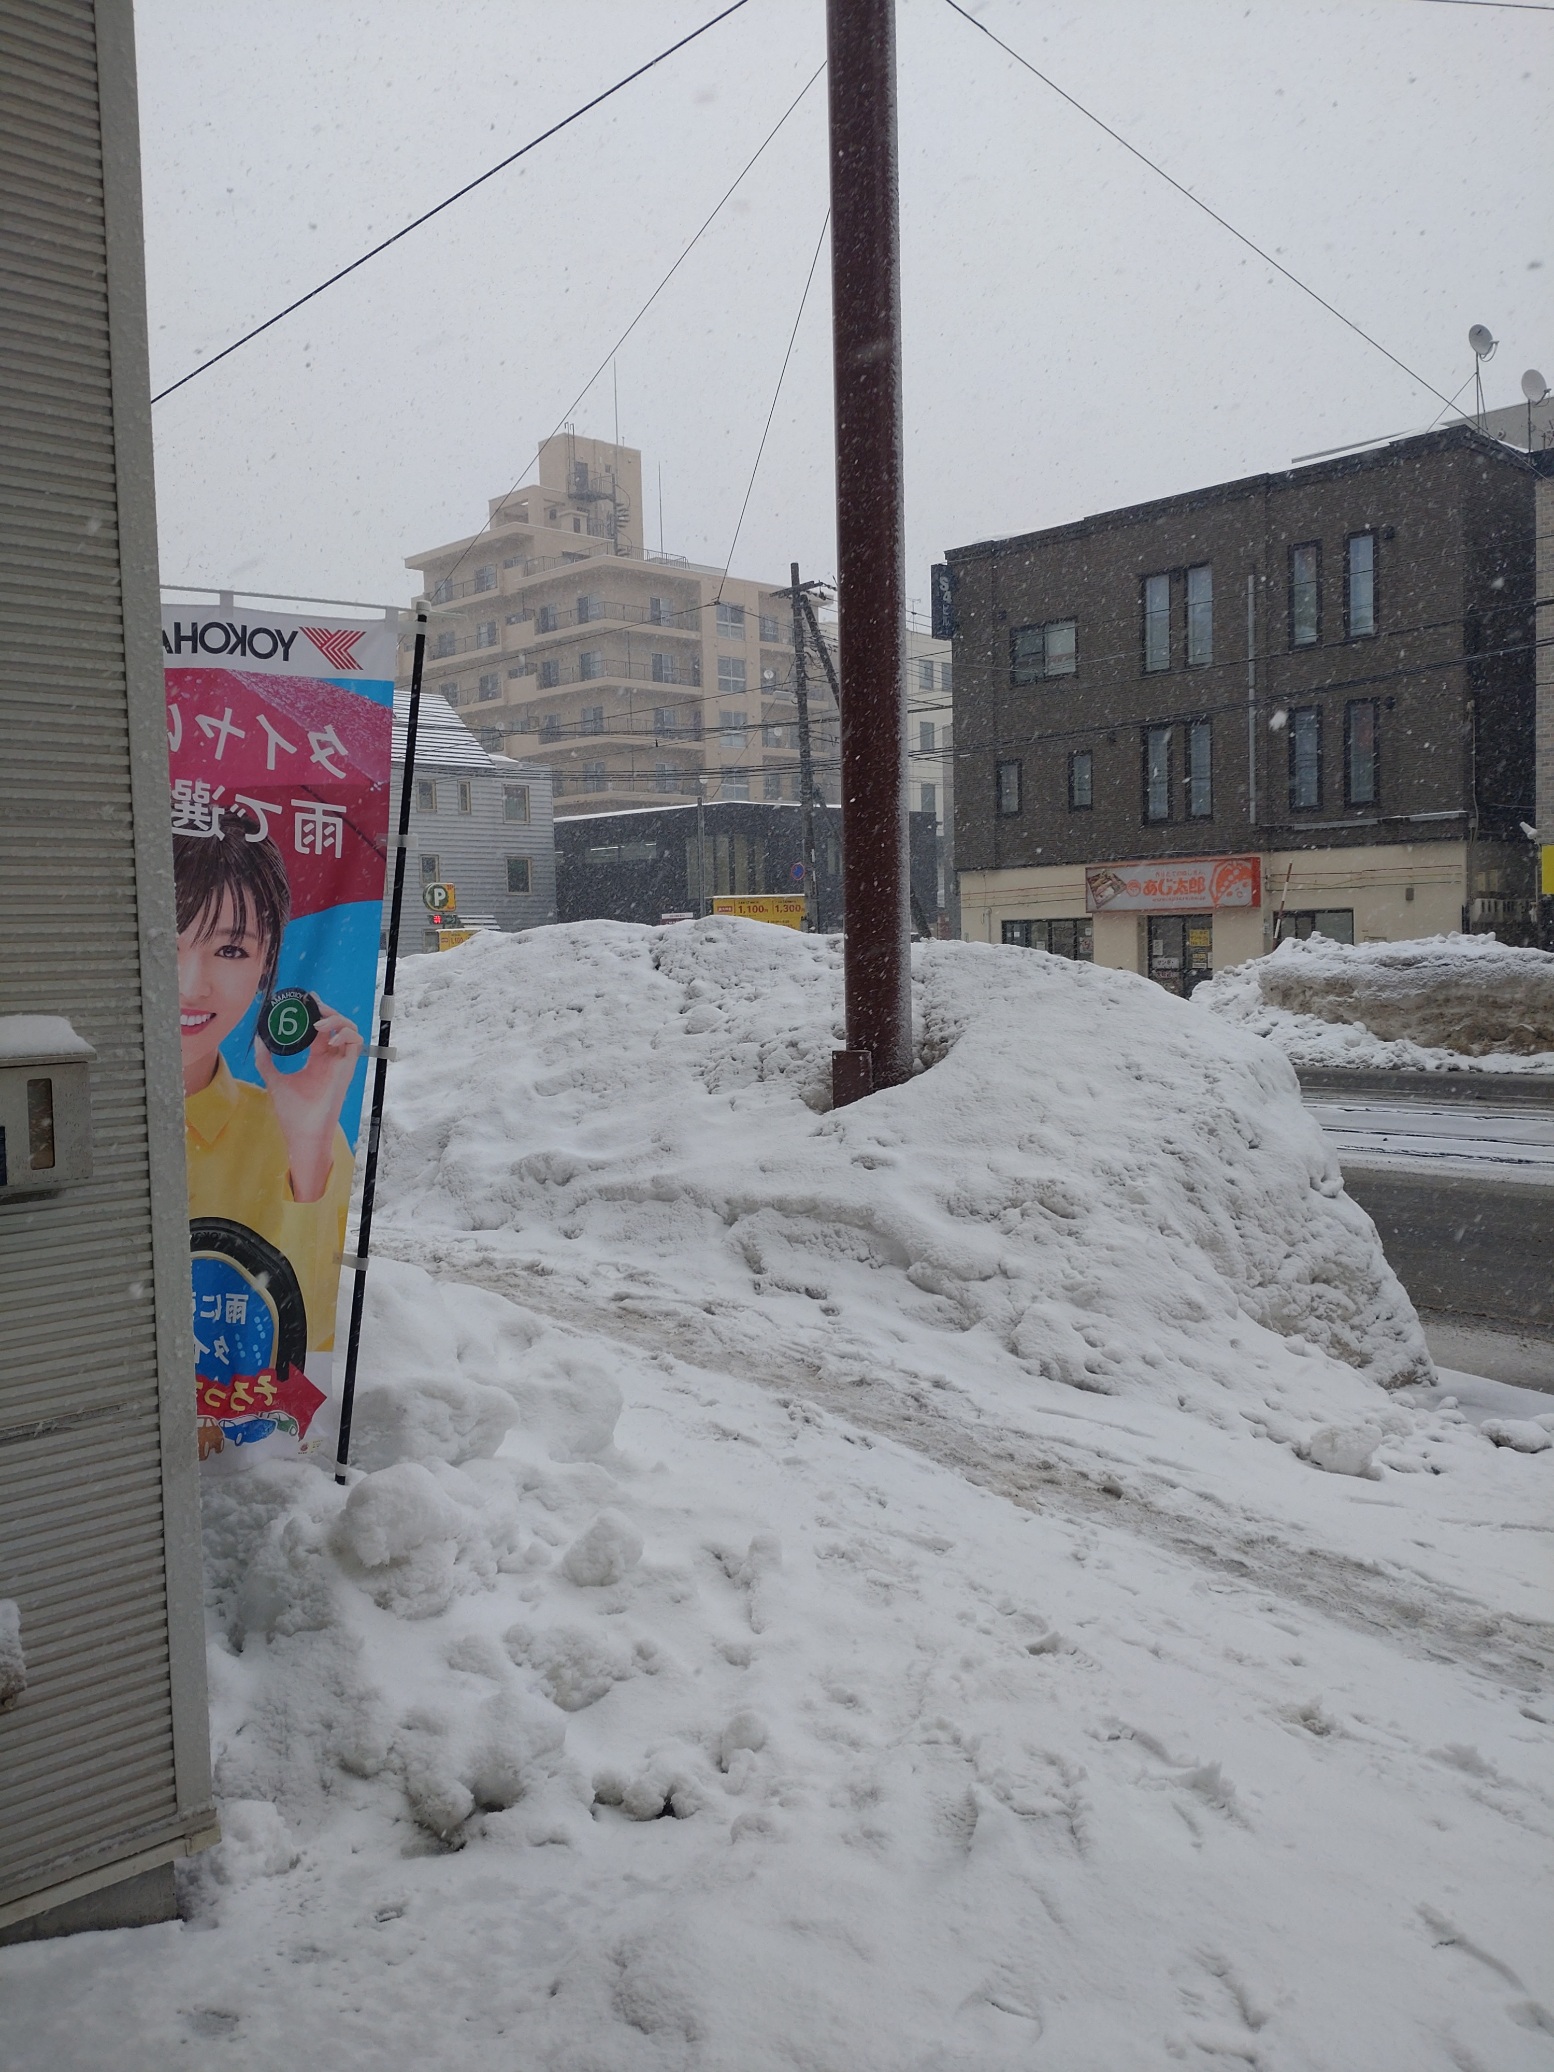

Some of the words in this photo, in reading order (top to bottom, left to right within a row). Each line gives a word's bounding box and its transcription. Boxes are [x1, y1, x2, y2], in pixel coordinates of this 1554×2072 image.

[1142, 877, 1206, 896] あじ太郎
[434, 888, 446, 906] P
